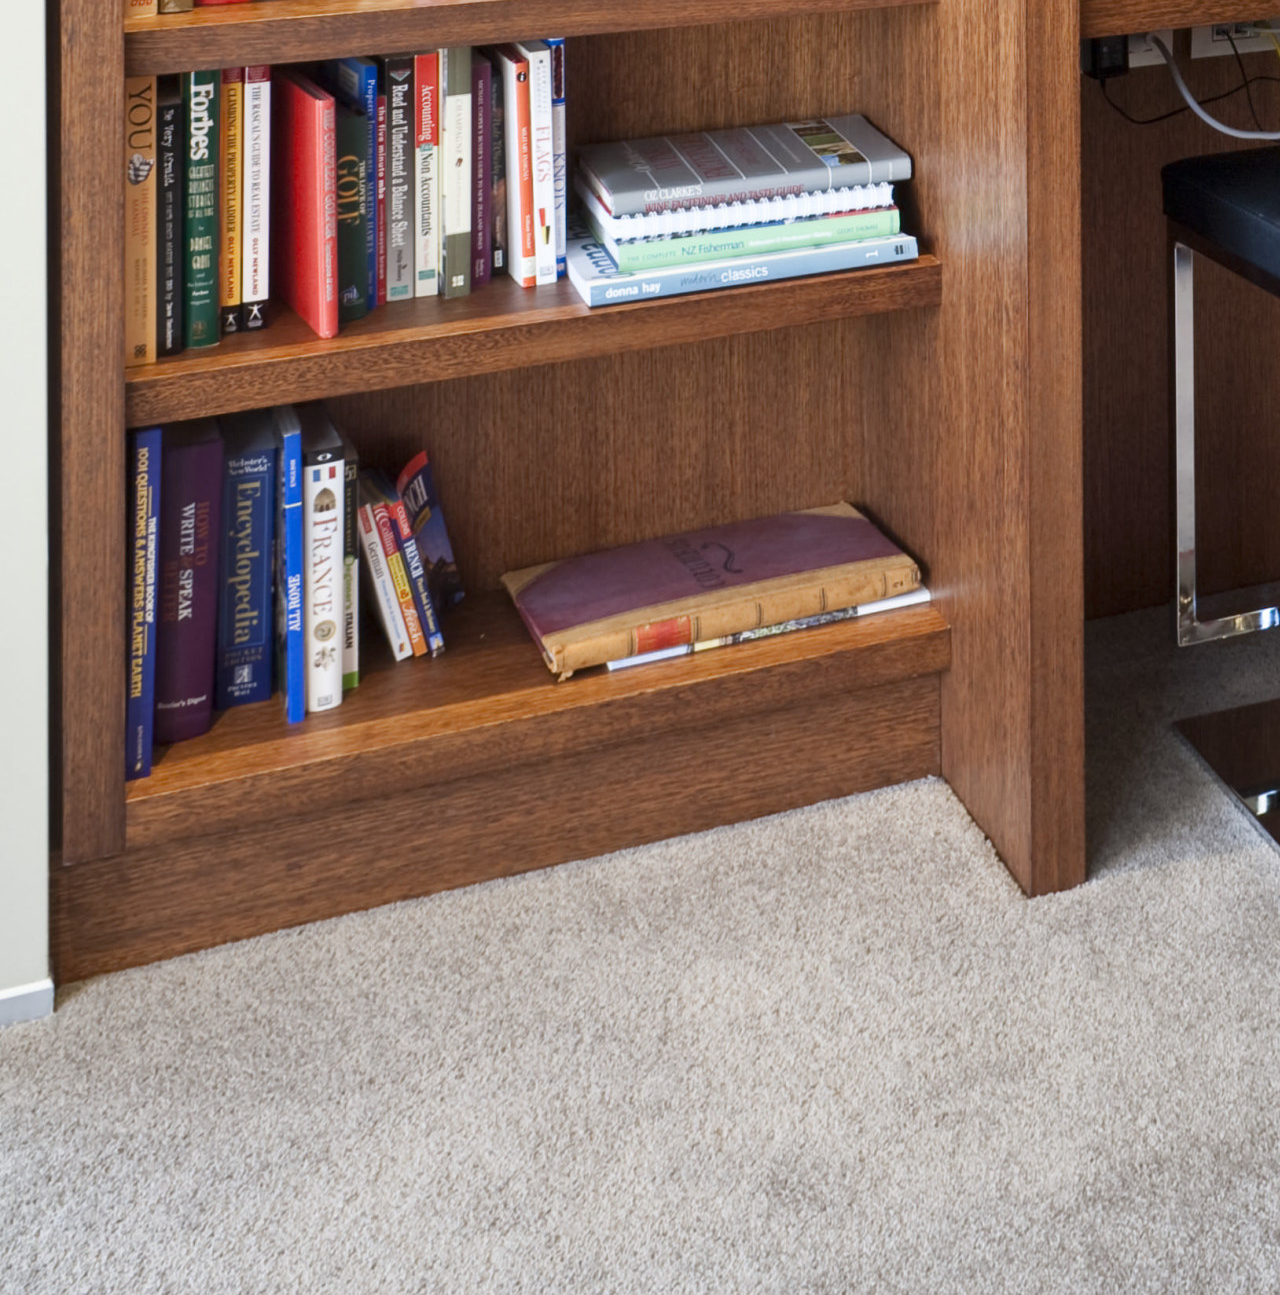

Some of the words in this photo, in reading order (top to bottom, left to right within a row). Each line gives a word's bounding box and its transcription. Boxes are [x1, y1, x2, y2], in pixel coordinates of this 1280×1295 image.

[392, 83, 409, 103] Read
[417, 84, 436, 141] Accounting
[128, 84, 153, 150] YOU
[190, 81, 215, 161] Forbes
[392, 105, 408, 124] and
[392, 124, 409, 177] Understand
[419, 152, 433, 174] Non
[535, 126, 552, 183] FLAGS
[392, 185, 409, 221] Balance
[418, 175, 433, 237] Accountants
[391, 221, 409, 248] Sheet
[681, 246, 697, 256] NZ
[698, 240, 745, 255] Fisherman
[605, 283, 639, 299] donna
[641, 281, 662, 299] hay
[179, 502, 196, 556] WRITE
[380, 519, 395, 555] Collins
[233, 479, 261, 646] Encyclopedia
[312, 514, 338, 617] FRANCE
[367, 540, 384, 579] German
[403, 537, 424, 579] FRENCH
[178, 569, 193, 622] SPEAK
[287, 573, 301, 605] ROME
[288, 605, 301, 631] ALL
